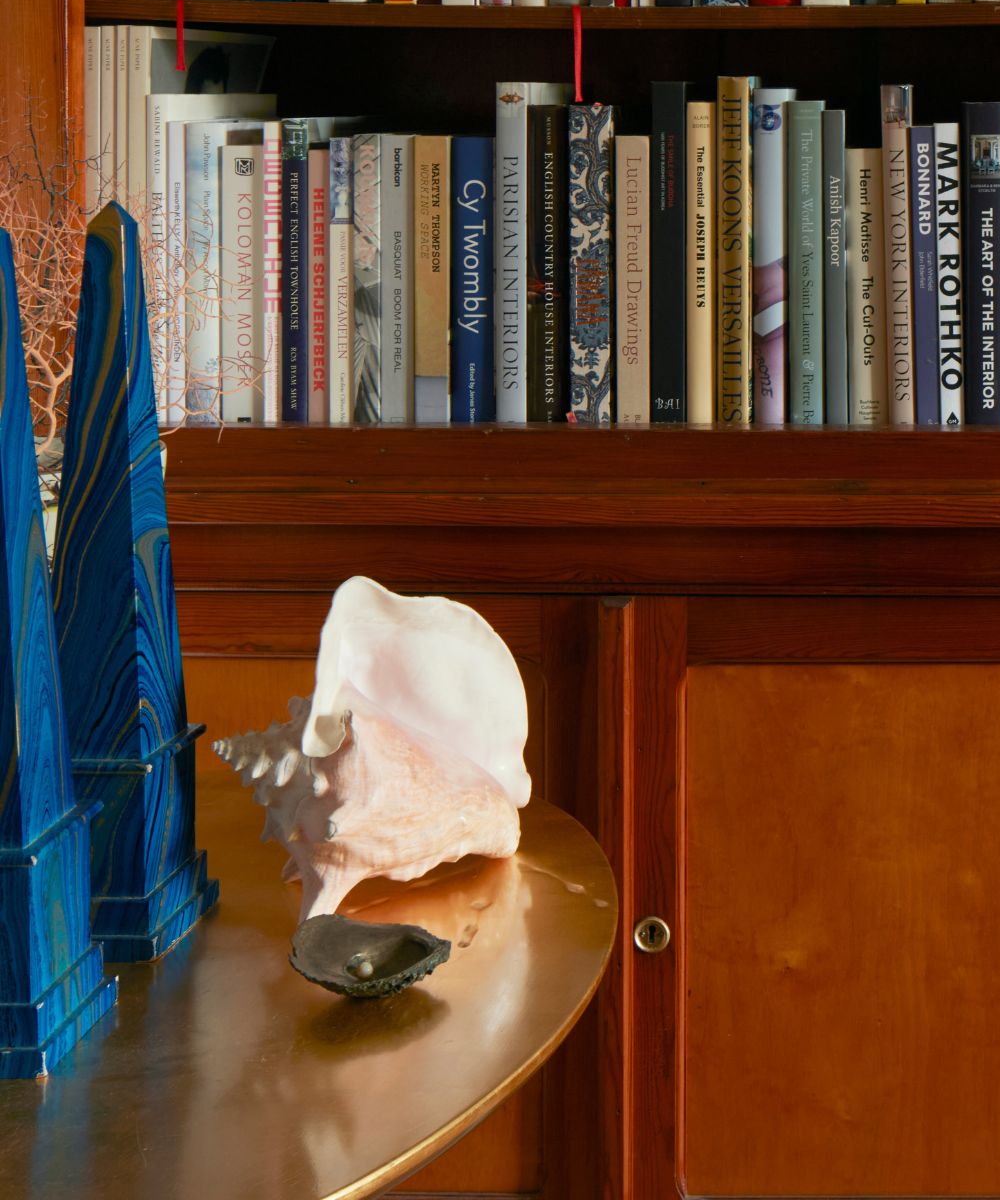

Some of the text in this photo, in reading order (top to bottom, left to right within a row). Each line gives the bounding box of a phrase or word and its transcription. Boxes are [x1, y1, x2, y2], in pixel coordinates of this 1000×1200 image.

[289, 173, 299, 330] PERFECT ENGLISH TOWNHOUSE
[394, 148, 402, 187] barbican
[432, 164, 440, 272] MARTYN THOMPSON
[457, 179, 487, 334] Cy Twombly
[721, 94, 742, 422] JEFF KOONS VERSAILLES
[827, 175, 842, 266] Anish Kapoor
[916, 143, 932, 235] BONNARD
[938, 142, 963, 390] MARK ROTHKO
[313, 188, 325, 391] HELENE SCHJERFBECK
[503, 156, 519, 390] PARISIAN INTERIORS
[860, 169, 875, 366] Henri Matisse The Cut-Outs
[889, 150, 910, 401] NEW YORK INTERIORS
[981, 208, 995, 408] THE ART OF THE INTERIOR
